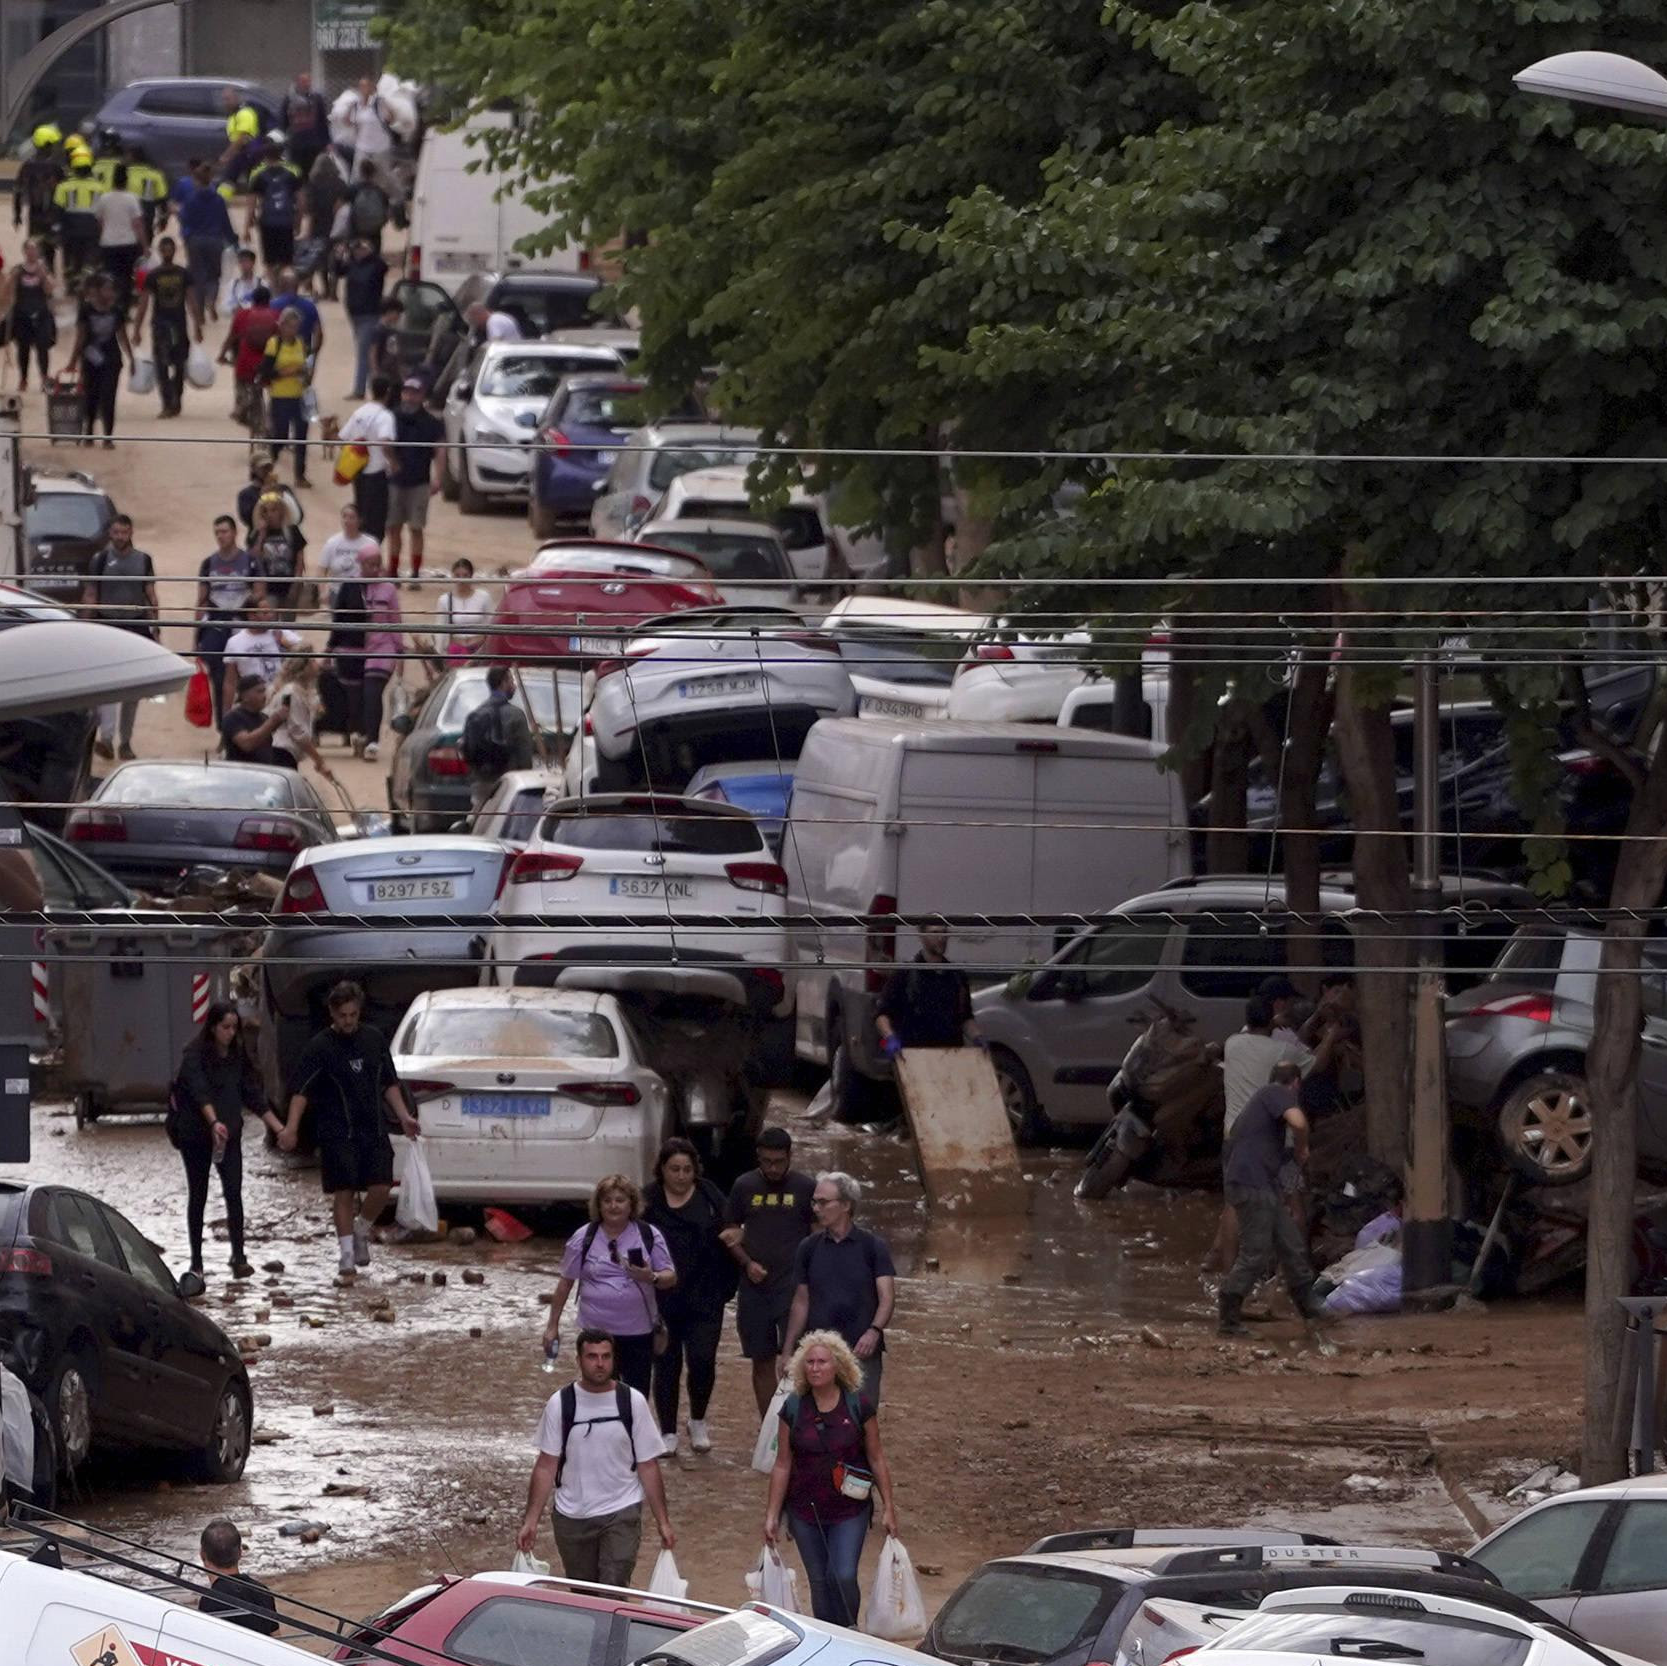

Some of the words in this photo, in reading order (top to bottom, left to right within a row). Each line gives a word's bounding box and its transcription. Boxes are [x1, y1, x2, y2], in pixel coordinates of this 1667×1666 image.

[378, 882, 416, 898] 8297
[419, 880, 451, 897] FSZ
[620, 879, 659, 895] 5637
[664, 882, 693, 897] KNL
[1268, 1549, 1360, 1559] DUSTER
